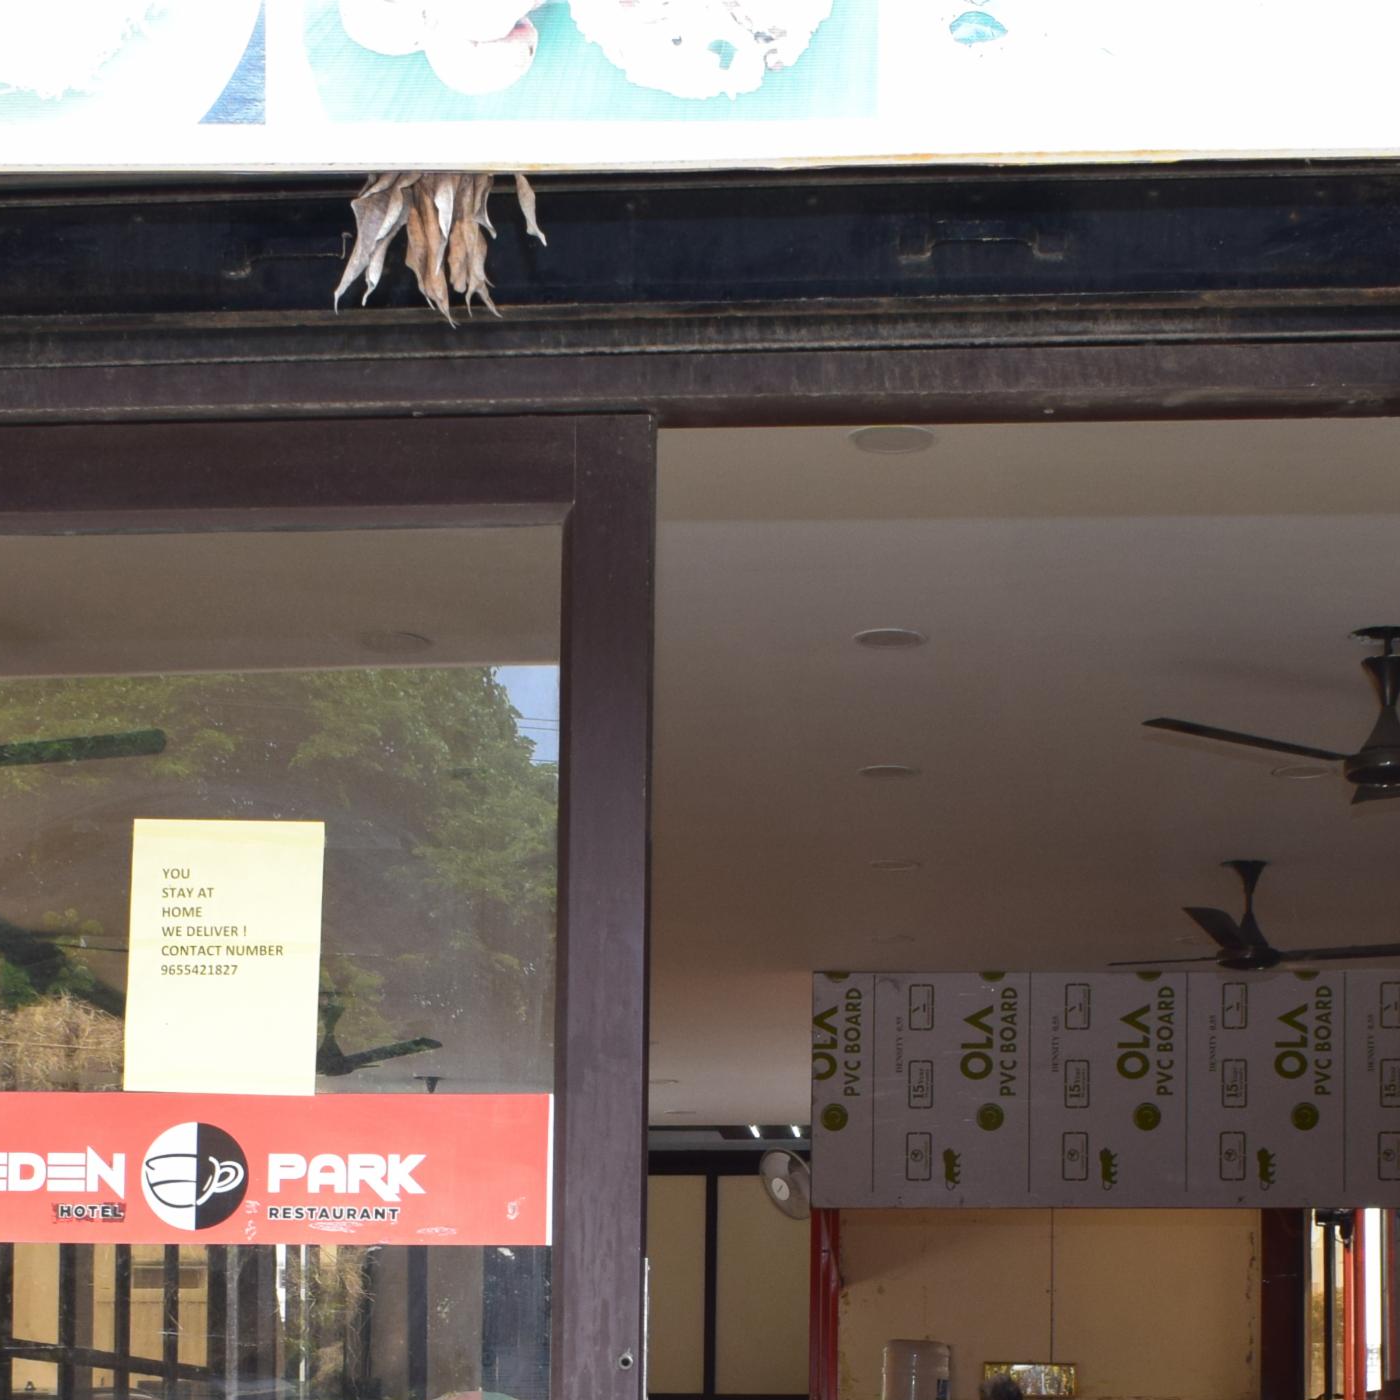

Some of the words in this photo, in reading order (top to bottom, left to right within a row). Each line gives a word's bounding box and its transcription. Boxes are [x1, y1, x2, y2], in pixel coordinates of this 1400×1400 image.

[161, 887, 194, 899] STAY
[197, 887, 215, 899] AT
[162, 868, 191, 880] YOU
[161, 906, 203, 918] HOME
[161, 926, 183, 937] WE
[186, 926, 239, 937] DELIVER
[160, 964, 238, 976] 9655421827
[161, 945, 222, 956] CONTACT
[225, 945, 284, 957] NUMBER
[843, 987, 863, 1054] BOARD
[999, 987, 1019, 1054] BOARD
[1156, 986, 1176, 1052] BOARD
[1314, 985, 1334, 1052] BOARD
[811, 1005, 840, 1081] OLA
[959, 1005, 995, 1081] OLA
[1116, 1004, 1152, 1080] OLA
[1274, 1003, 1309, 1079] OLA
[843, 1059, 862, 1097] PVC
[912, 1085, 925, 1099] 15
[999, 1059, 1018, 1097] PVC
[1068, 1085, 1081, 1099] 15
[1156, 1059, 1175, 1097] PVC
[1226, 1084, 1239, 1098] 15
[1314, 1058, 1333, 1096] PVC
[1384, 1084, 1397, 1098] 15
[268, 1153, 427, 1202] PARK
[58, 1203, 124, 1220] HOTEL
[268, 1205, 401, 1221] RESTAURANT
